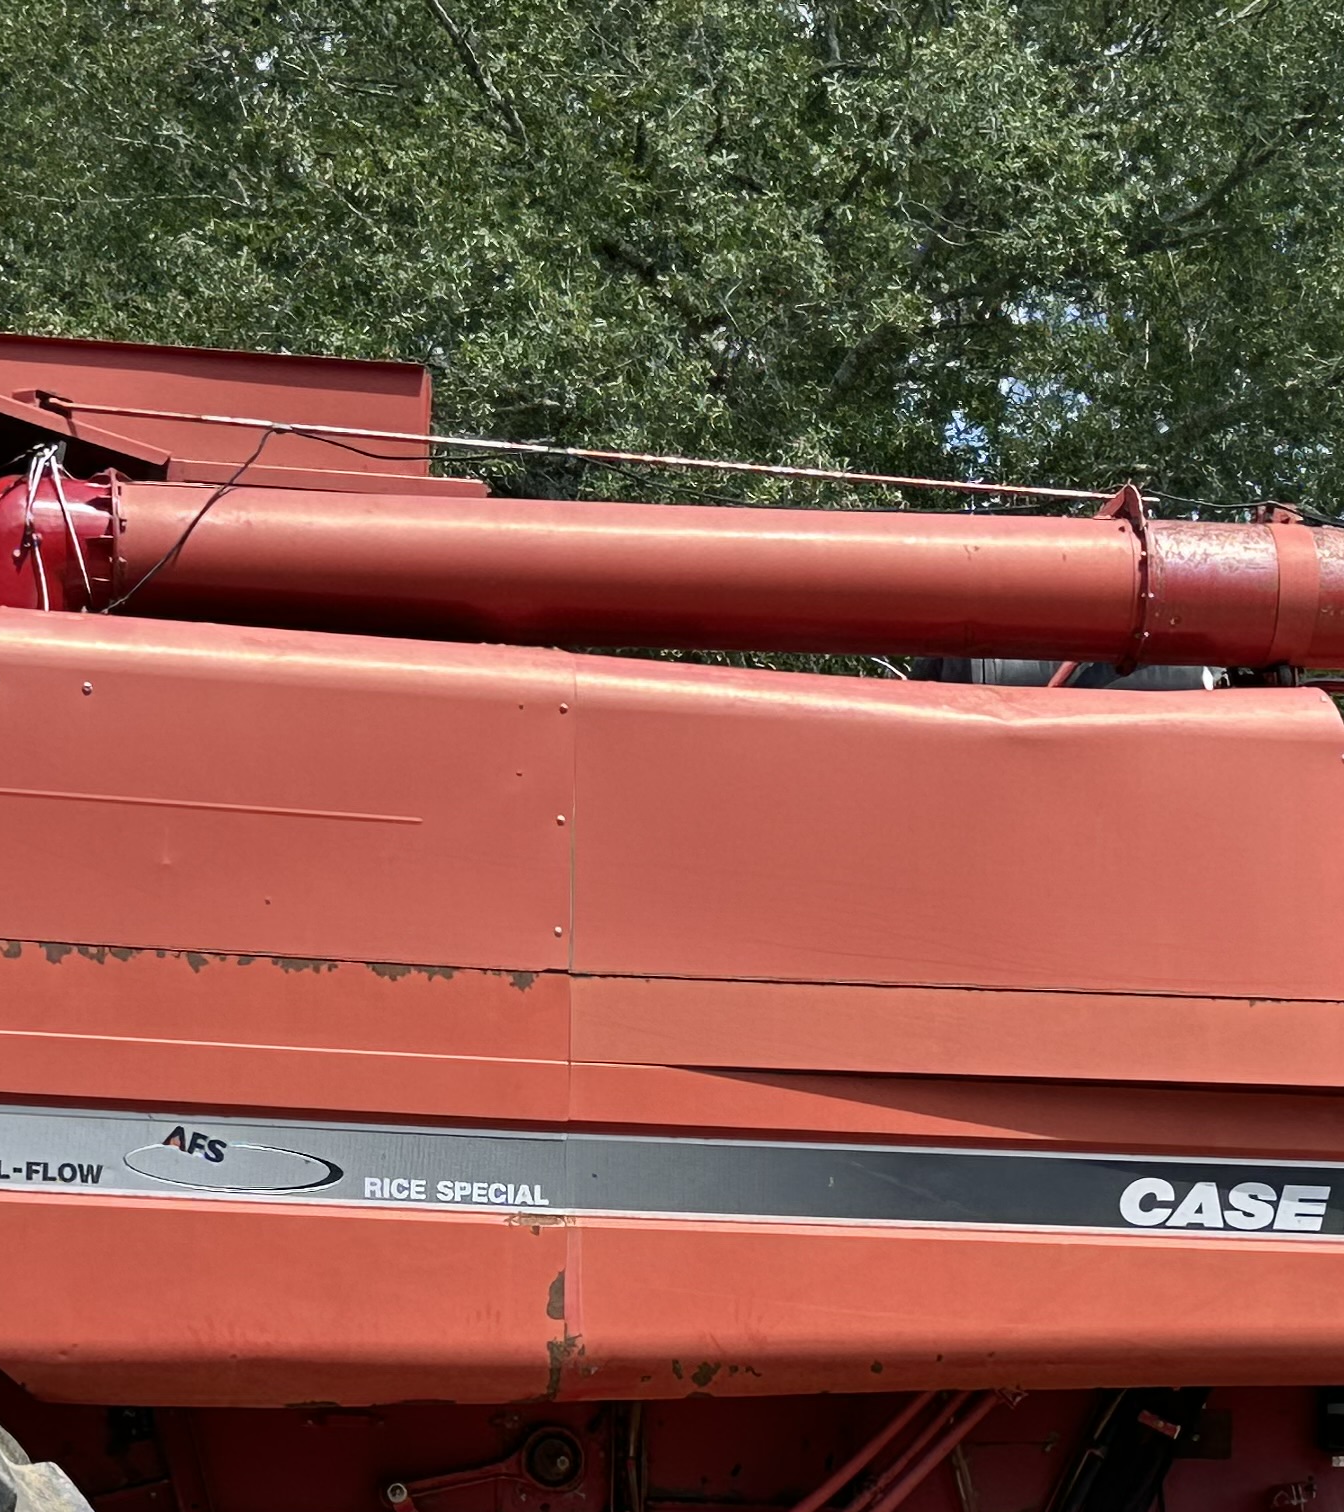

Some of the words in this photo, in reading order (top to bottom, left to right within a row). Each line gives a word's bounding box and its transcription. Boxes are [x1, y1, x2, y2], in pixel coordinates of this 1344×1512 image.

[162, 1125, 227, 1163] AFS
[364, 1177, 426, 1200] RICE
[437, 1180, 549, 1206] SPECIAL
[1119, 1177, 1331, 1231] CASE
